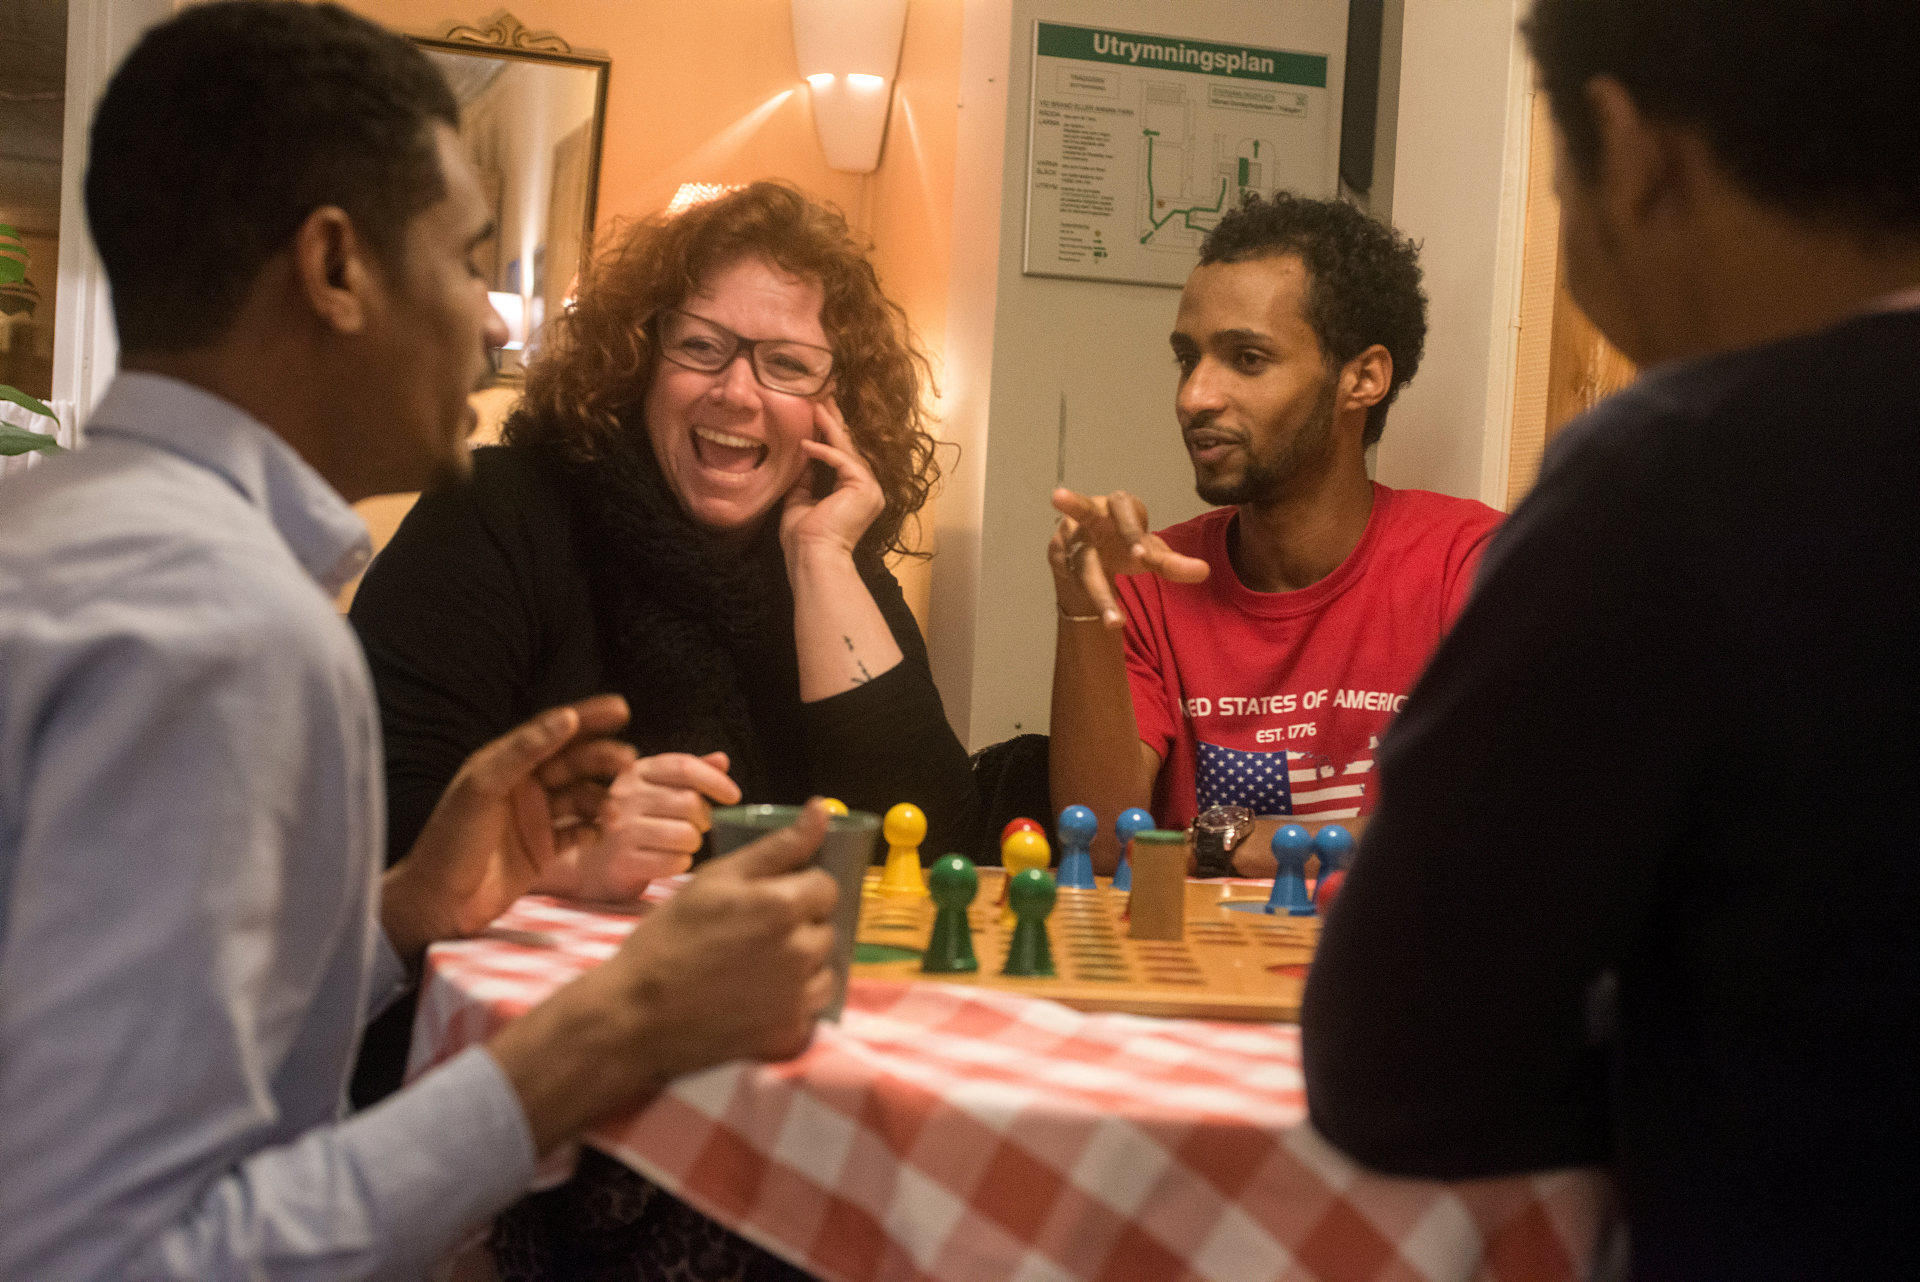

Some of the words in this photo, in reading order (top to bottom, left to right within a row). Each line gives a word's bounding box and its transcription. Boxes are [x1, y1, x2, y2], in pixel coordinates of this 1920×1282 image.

[1093, 33, 1274, 74] Utrymningsplan
[1218, 694, 1297, 716] STATES
[1303, 689, 1328, 710] OF
[1256, 728, 1285, 743] EST.
[1288, 722, 1317, 739] 1776
